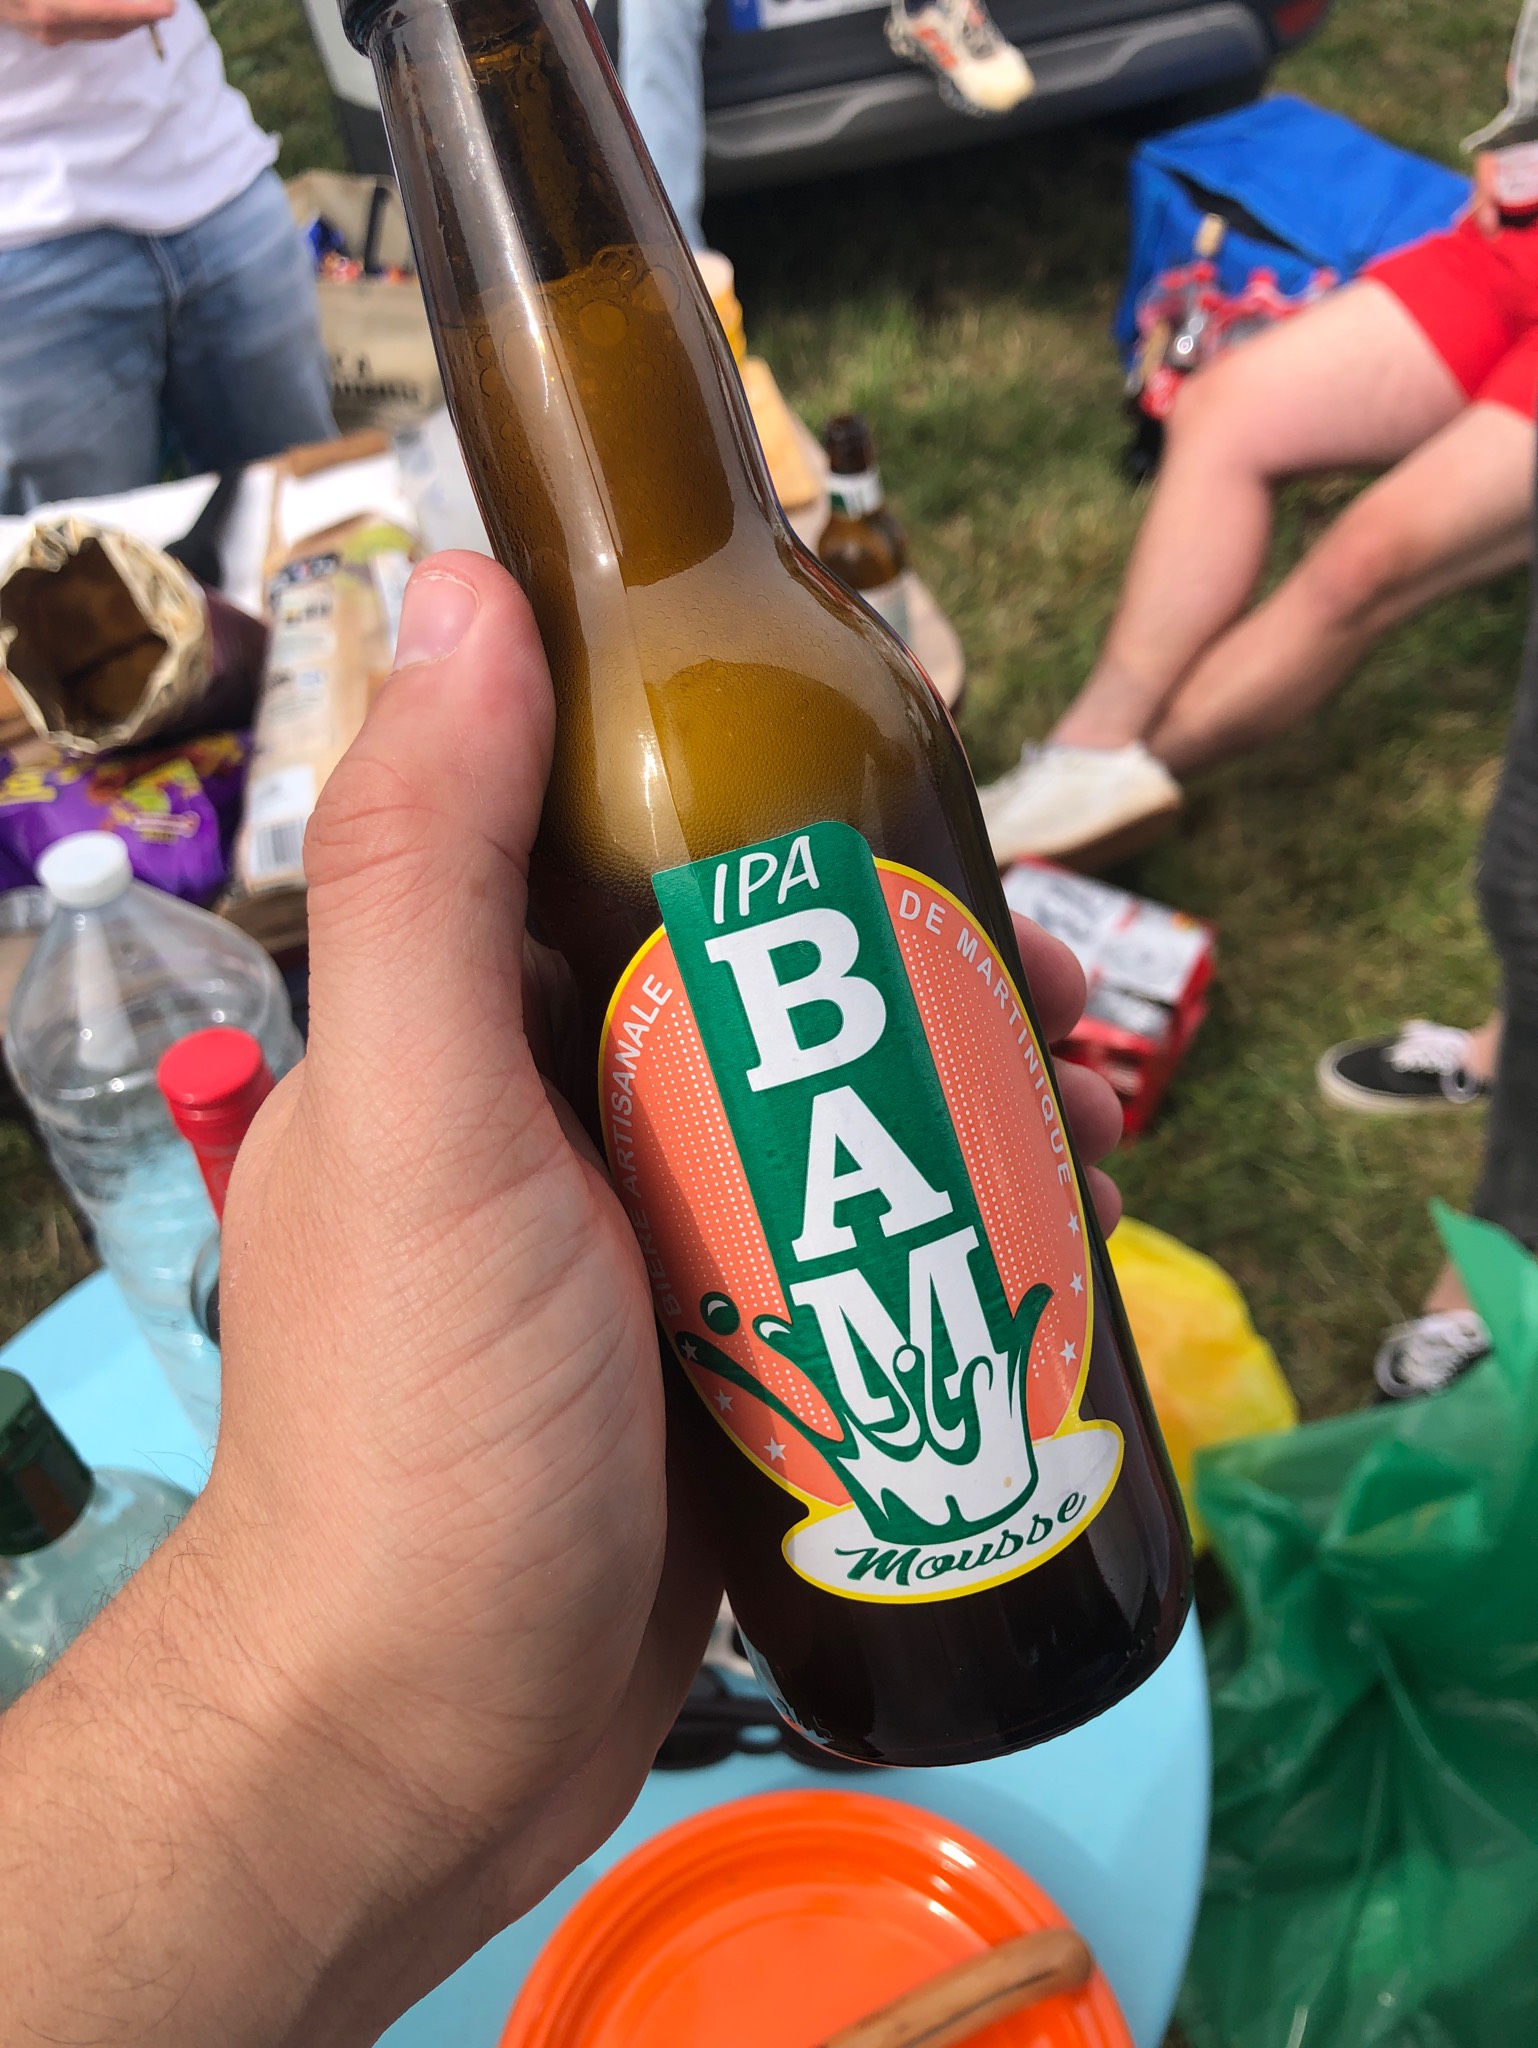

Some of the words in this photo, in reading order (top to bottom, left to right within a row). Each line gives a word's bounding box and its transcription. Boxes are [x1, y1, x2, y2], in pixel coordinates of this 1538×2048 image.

[713, 836, 820, 924] IPA
[611, 973, 673, 1198] ARTISANALE
[900, 889, 946, 935] DE
[957, 928, 1073, 1186] MARTINIQUE
[704, 908, 1008, 1427] BAM
[834, 1494, 1088, 1587] Mousse
